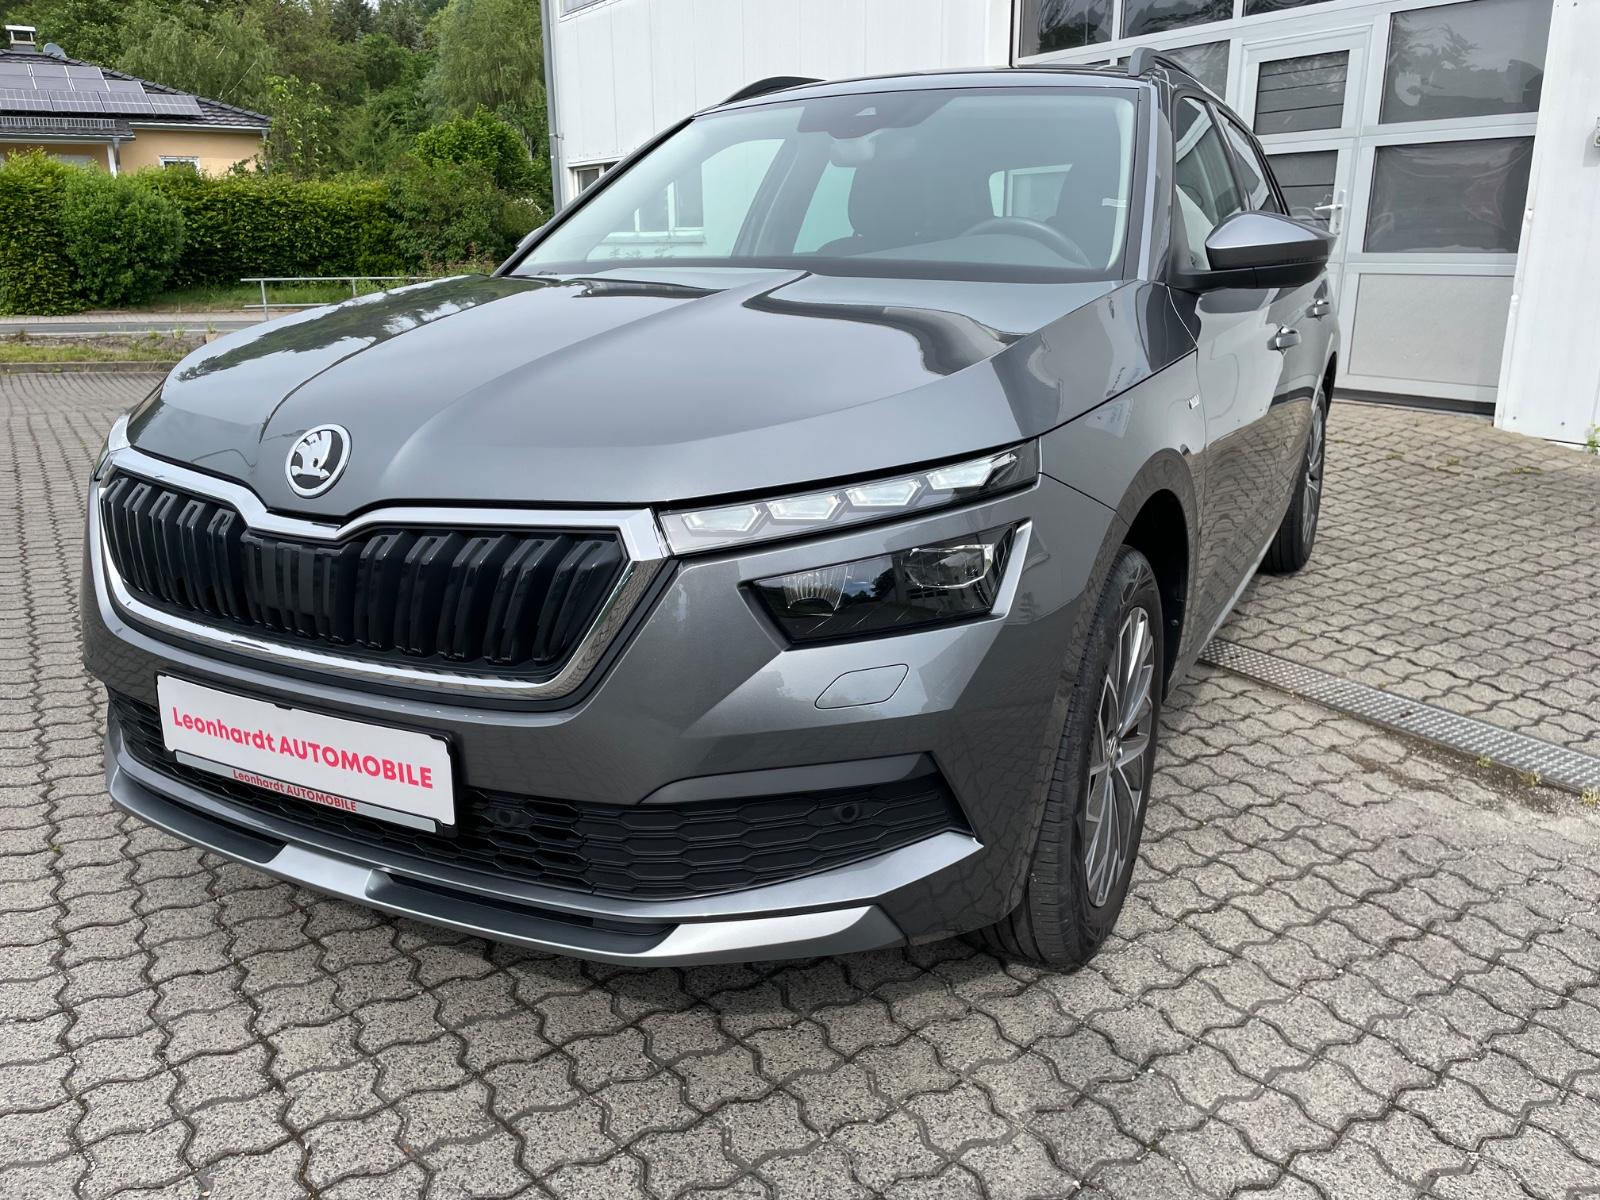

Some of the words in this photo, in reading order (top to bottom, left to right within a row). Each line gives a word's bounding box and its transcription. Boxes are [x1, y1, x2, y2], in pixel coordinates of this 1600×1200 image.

[172, 706, 275, 752] Leonhardt
[279, 736, 433, 789] AUTOMOBILE
[233, 769, 285, 793] Leonhardt
[286, 785, 357, 812] AUTOMOBILE
